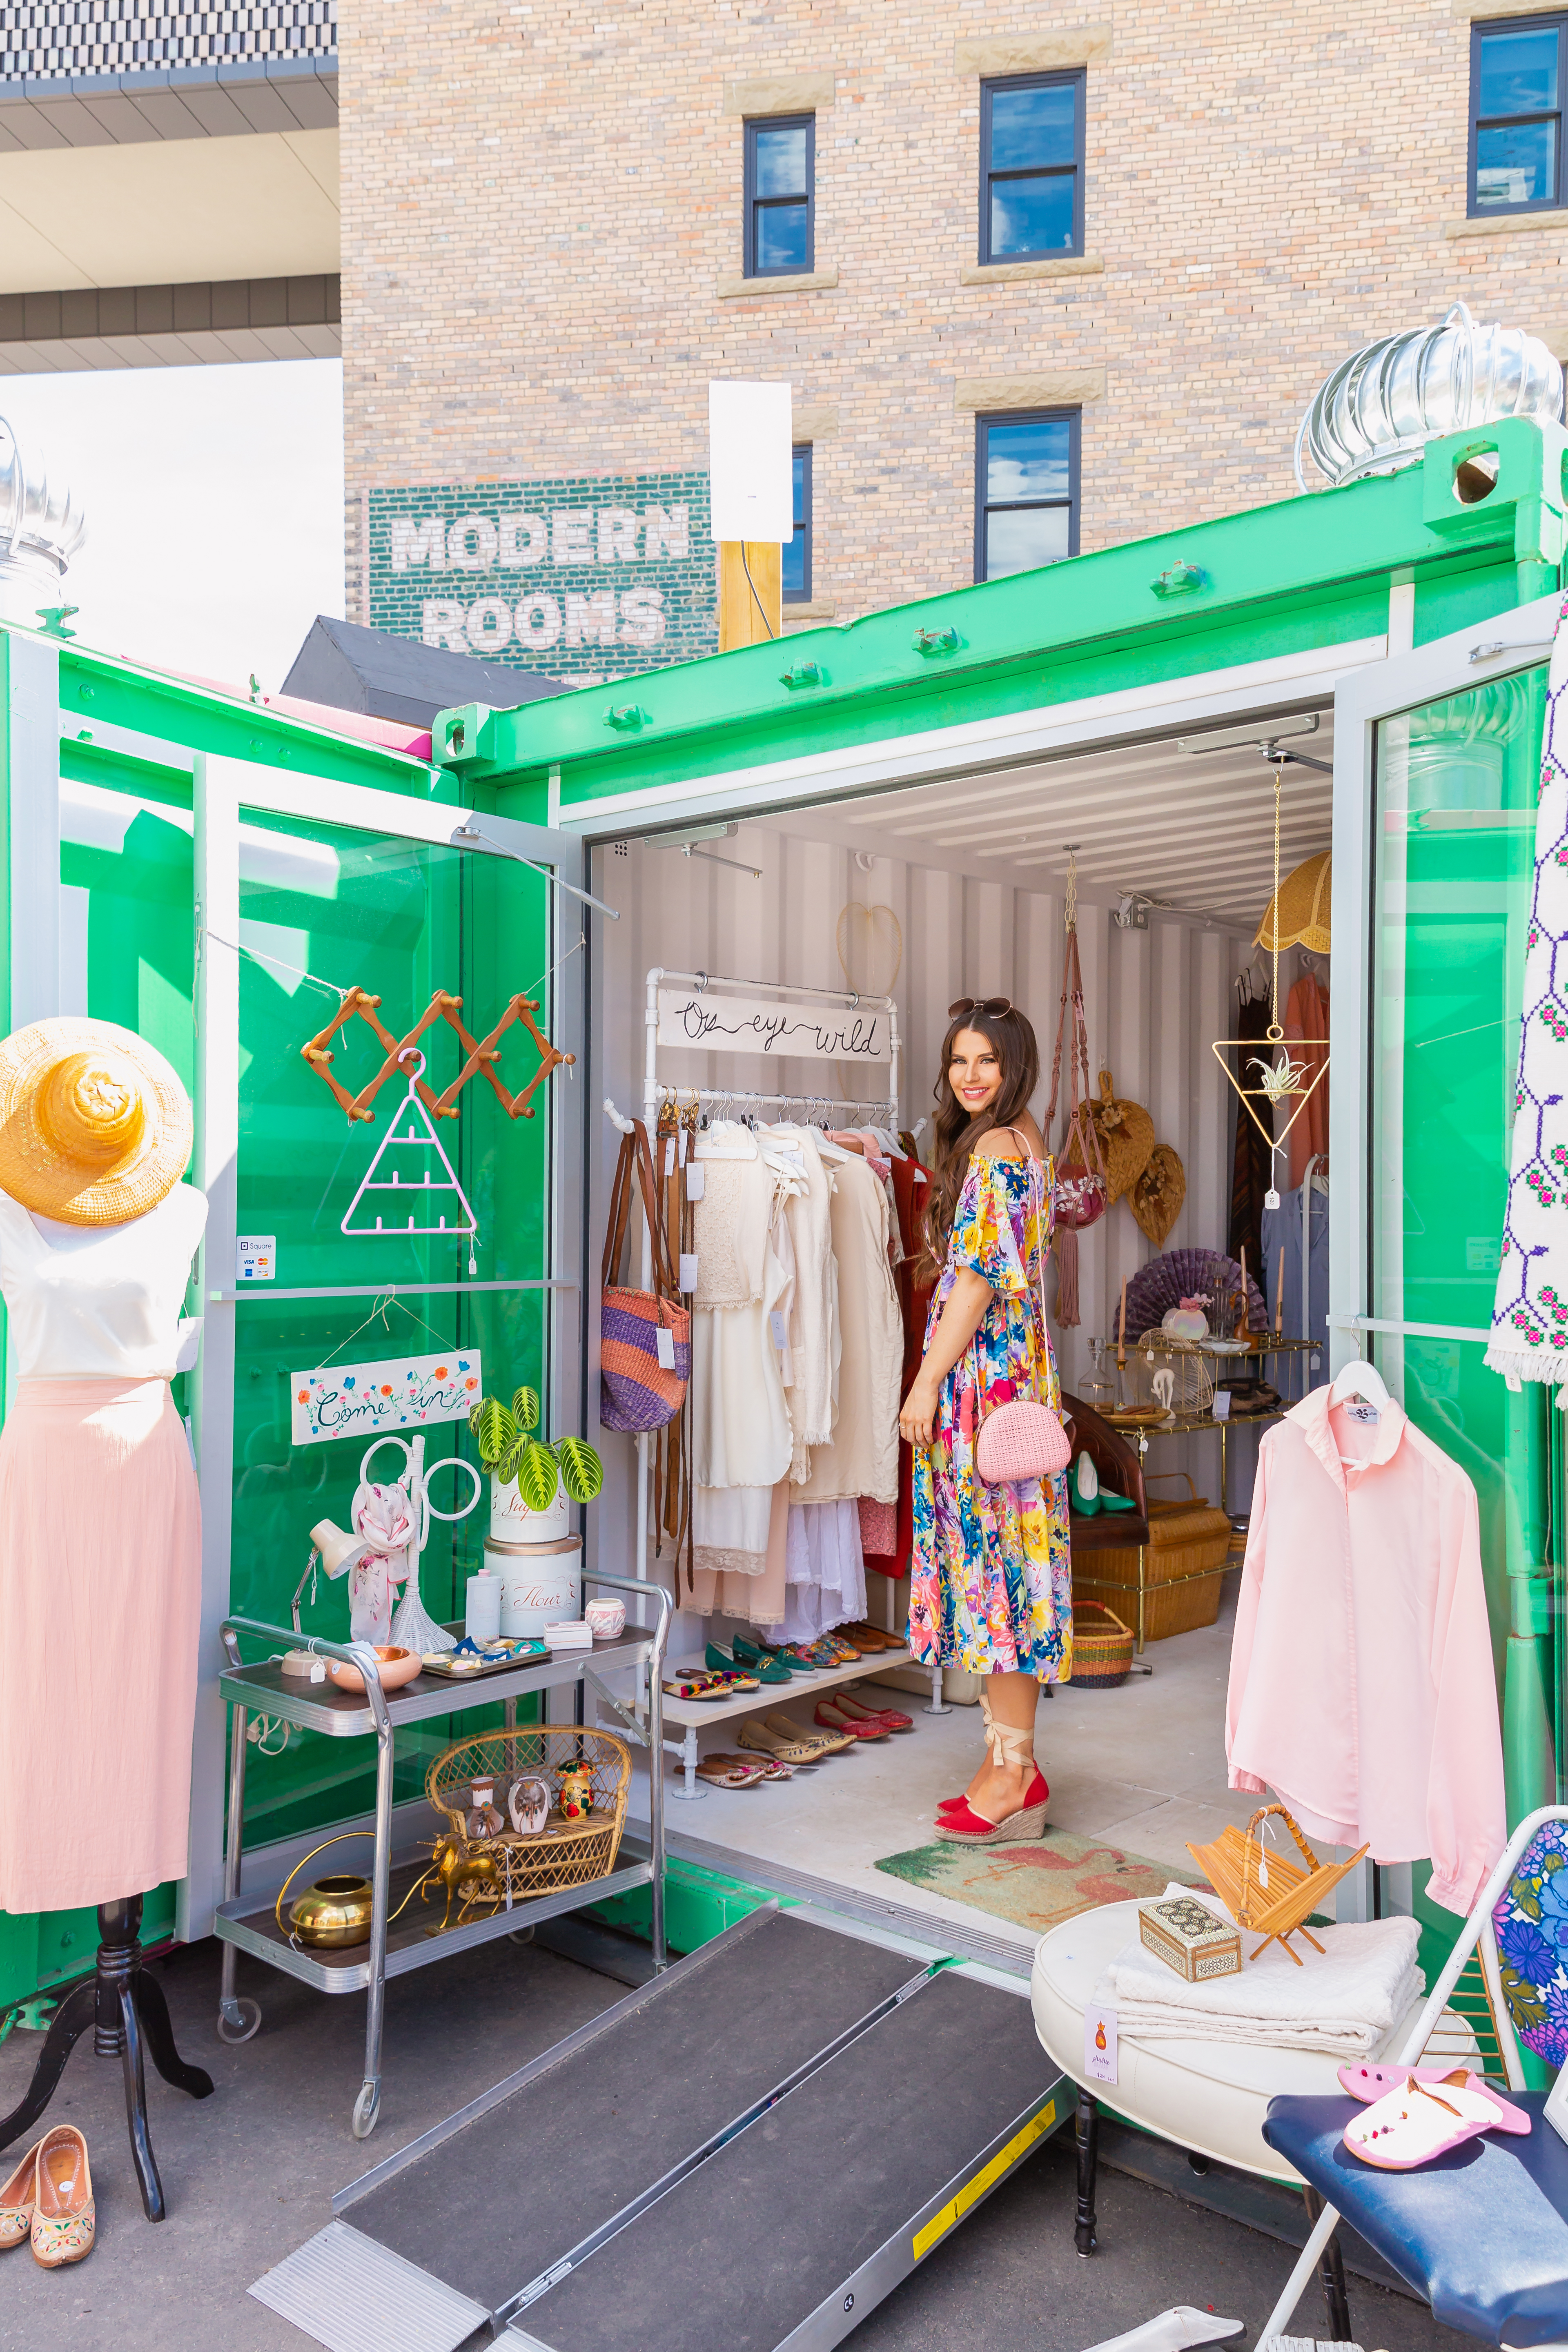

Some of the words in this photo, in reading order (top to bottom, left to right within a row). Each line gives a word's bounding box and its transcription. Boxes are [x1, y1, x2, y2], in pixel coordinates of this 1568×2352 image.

[392, 505, 689, 570] MODERN
[423, 587, 666, 654] ROOMS
[816, 1018, 881, 1055] wild
[316, 1392, 390, 1427] Come
[405, 1391, 466, 1408] in
[513, 1586, 564, 1607] Flour
[1092, 2055, 1110, 2065] prairie
[1094, 2061, 1109, 2070] BAZAAR
